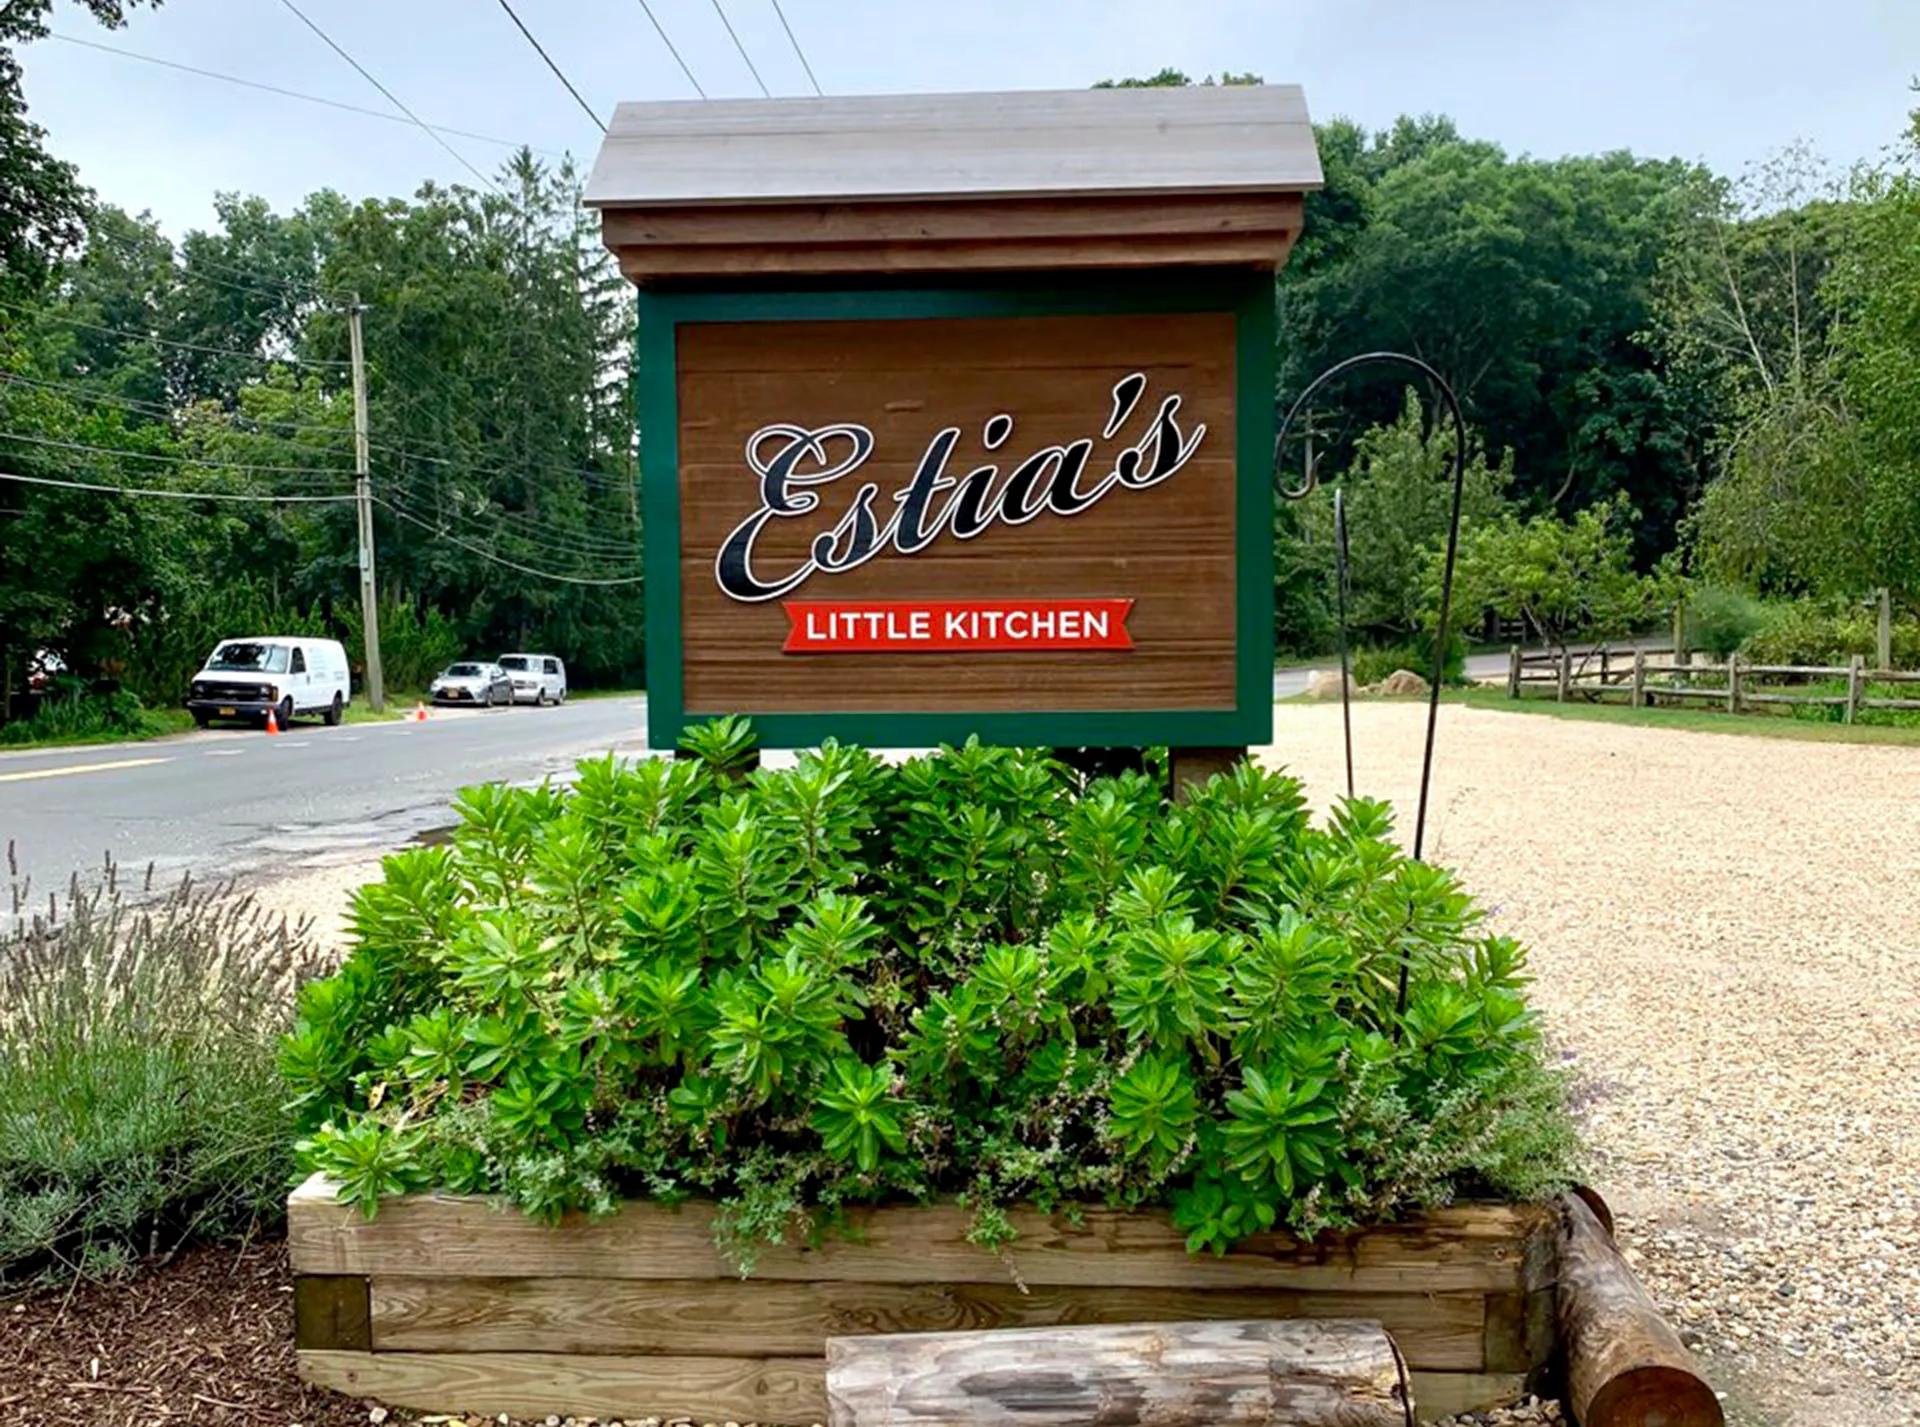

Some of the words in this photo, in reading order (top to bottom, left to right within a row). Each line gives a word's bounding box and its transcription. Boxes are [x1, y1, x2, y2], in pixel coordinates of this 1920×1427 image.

[715, 372, 1206, 602] Estia's
[806, 612, 930, 640] LITTLE
[944, 610, 1108, 639] KITCHEN
